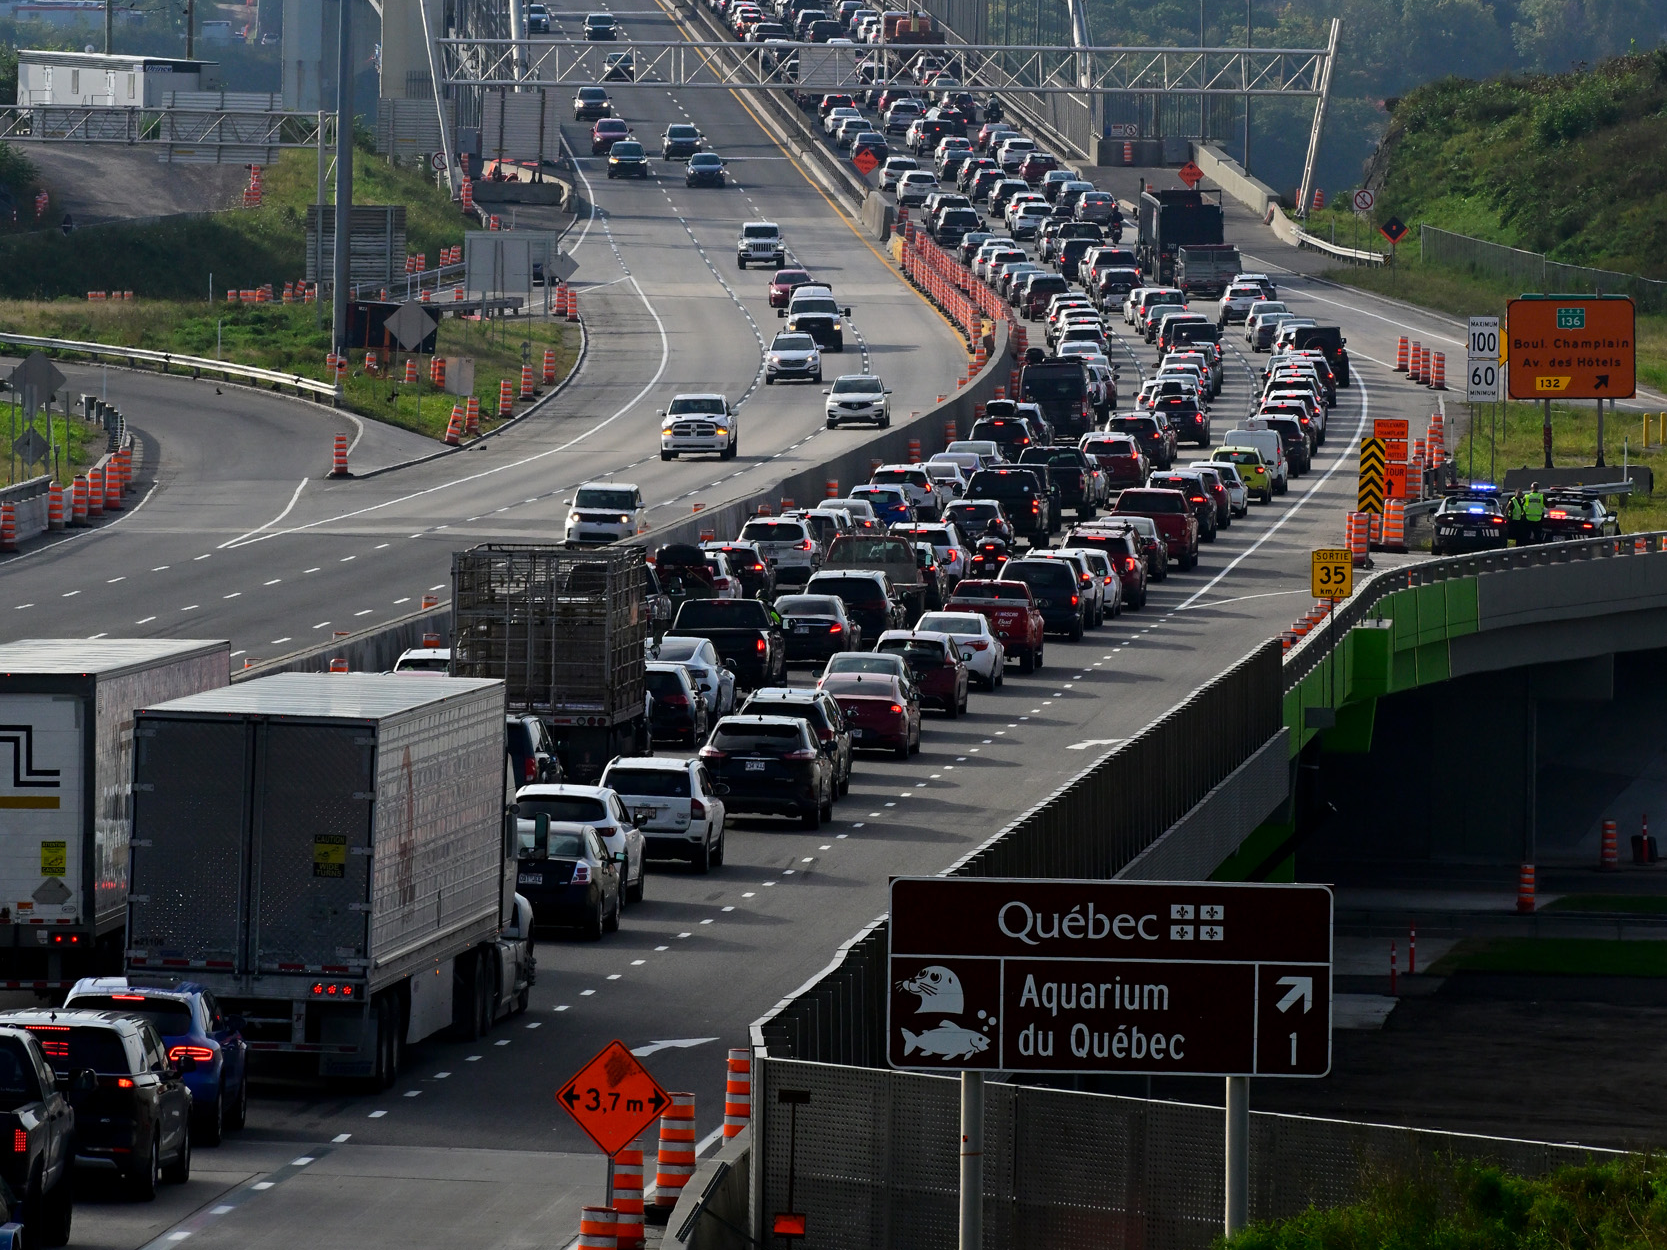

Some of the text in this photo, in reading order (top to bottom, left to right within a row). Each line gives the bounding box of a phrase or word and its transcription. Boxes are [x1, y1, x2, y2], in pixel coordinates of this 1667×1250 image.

[1561, 316, 1581, 326] 136
[1471, 332, 1497, 352] 100
[1514, 338, 1629, 350] Boul. Champlain
[1523, 357, 1621, 367] Av. des Hôtels
[1472, 366, 1495, 386] 60
[1540, 378, 1560, 388] 132
[1385, 468, 1404, 477] TOUR
[1316, 552, 1349, 561] SORTIE
[1319, 566, 1346, 584] 35
[1320, 587, 1344, 596] km/h
[315, 835, 345, 844] CAUTION
[319, 863, 340, 871] WIDE
[315, 869, 342, 877] TURNS
[998, 901, 1160, 946] Québec
[1019, 974, 1169, 1016] Aquarium
[1018, 1023, 1186, 1061] du Québec
[1289, 1031, 1298, 1066] 1
[585, 1087, 644, 1115] 3,7 m
